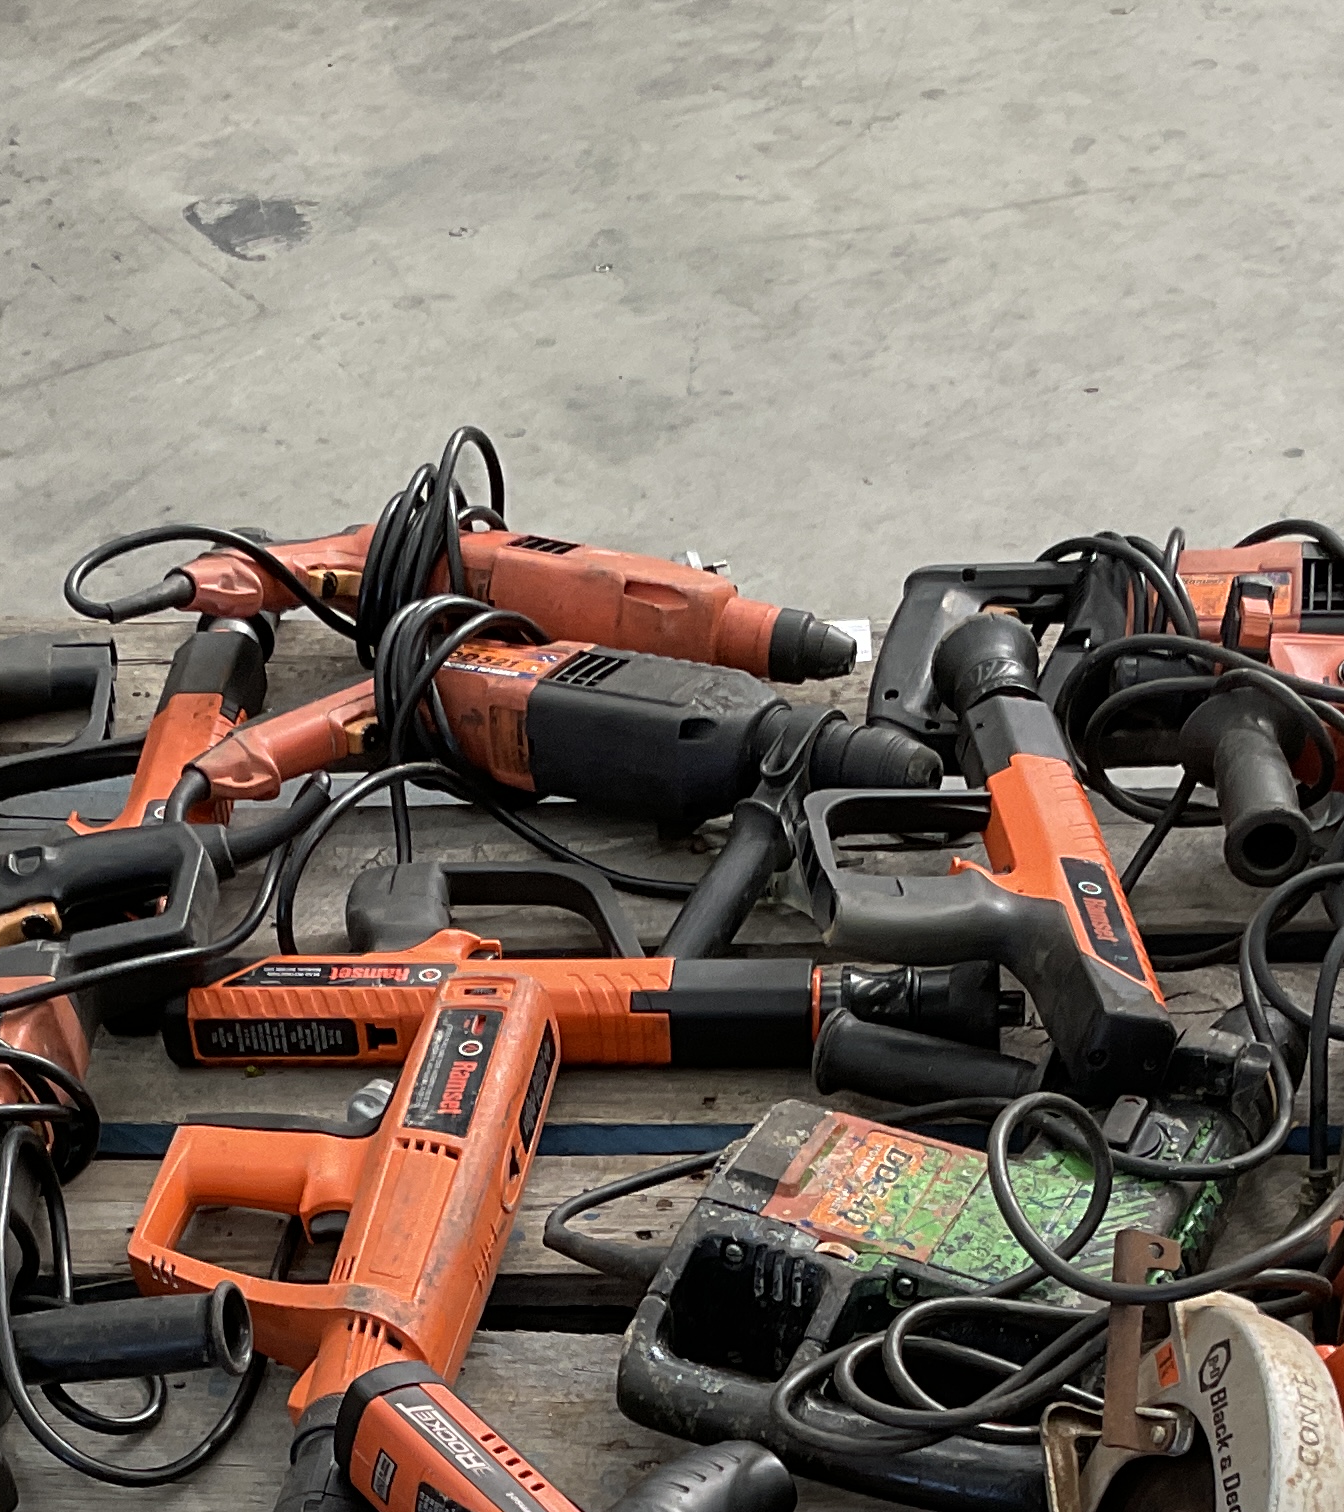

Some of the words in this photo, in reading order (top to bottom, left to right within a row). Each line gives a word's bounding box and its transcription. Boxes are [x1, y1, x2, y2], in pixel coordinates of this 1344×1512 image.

[329, 966, 411, 982] Ramset
[437, 1060, 478, 1117] Ramset
[394, 1402, 488, 1471] ROCKET
[1209, 1387, 1234, 1451] Black
